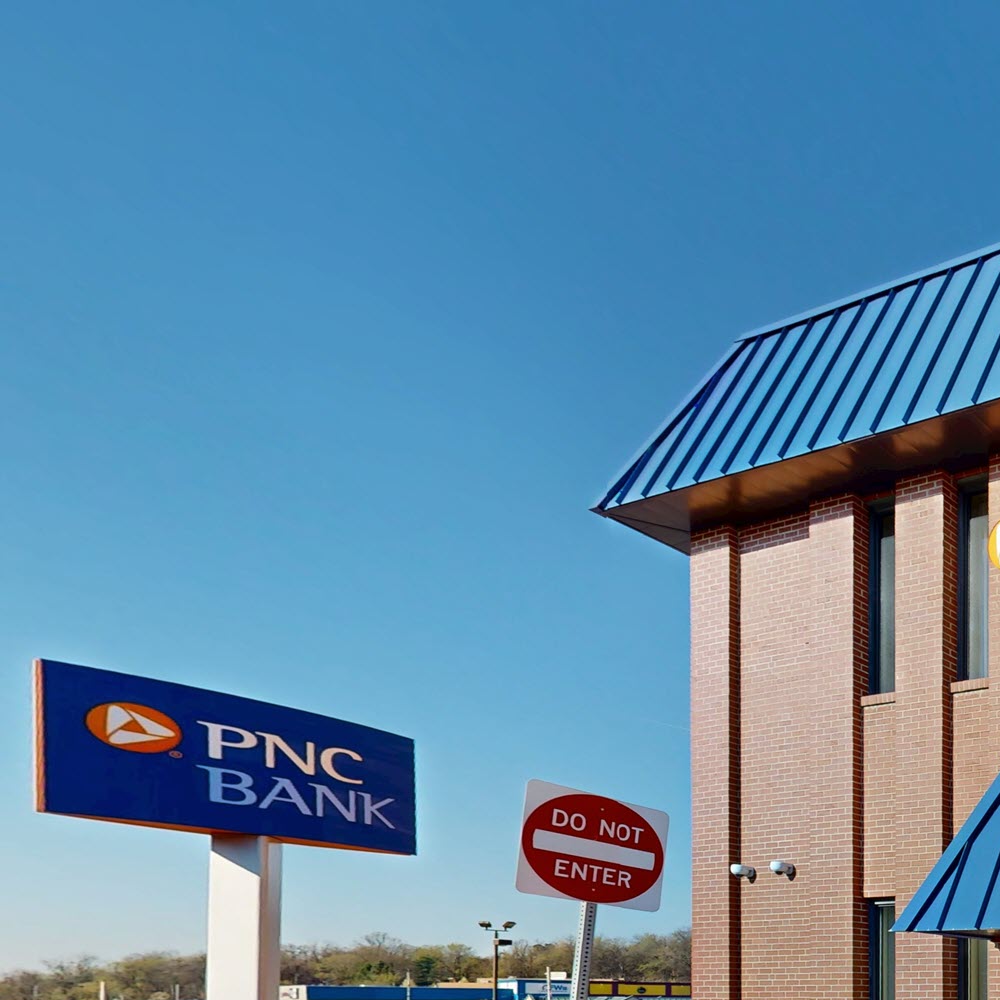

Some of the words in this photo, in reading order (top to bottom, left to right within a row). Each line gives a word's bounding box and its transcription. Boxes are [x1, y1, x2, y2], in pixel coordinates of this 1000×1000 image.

[195, 720, 363, 785] PNC
[195, 764, 396, 830] BANK
[551, 808, 587, 832] DO
[599, 819, 645, 844] NOT
[553, 858, 632, 889] ENTER
